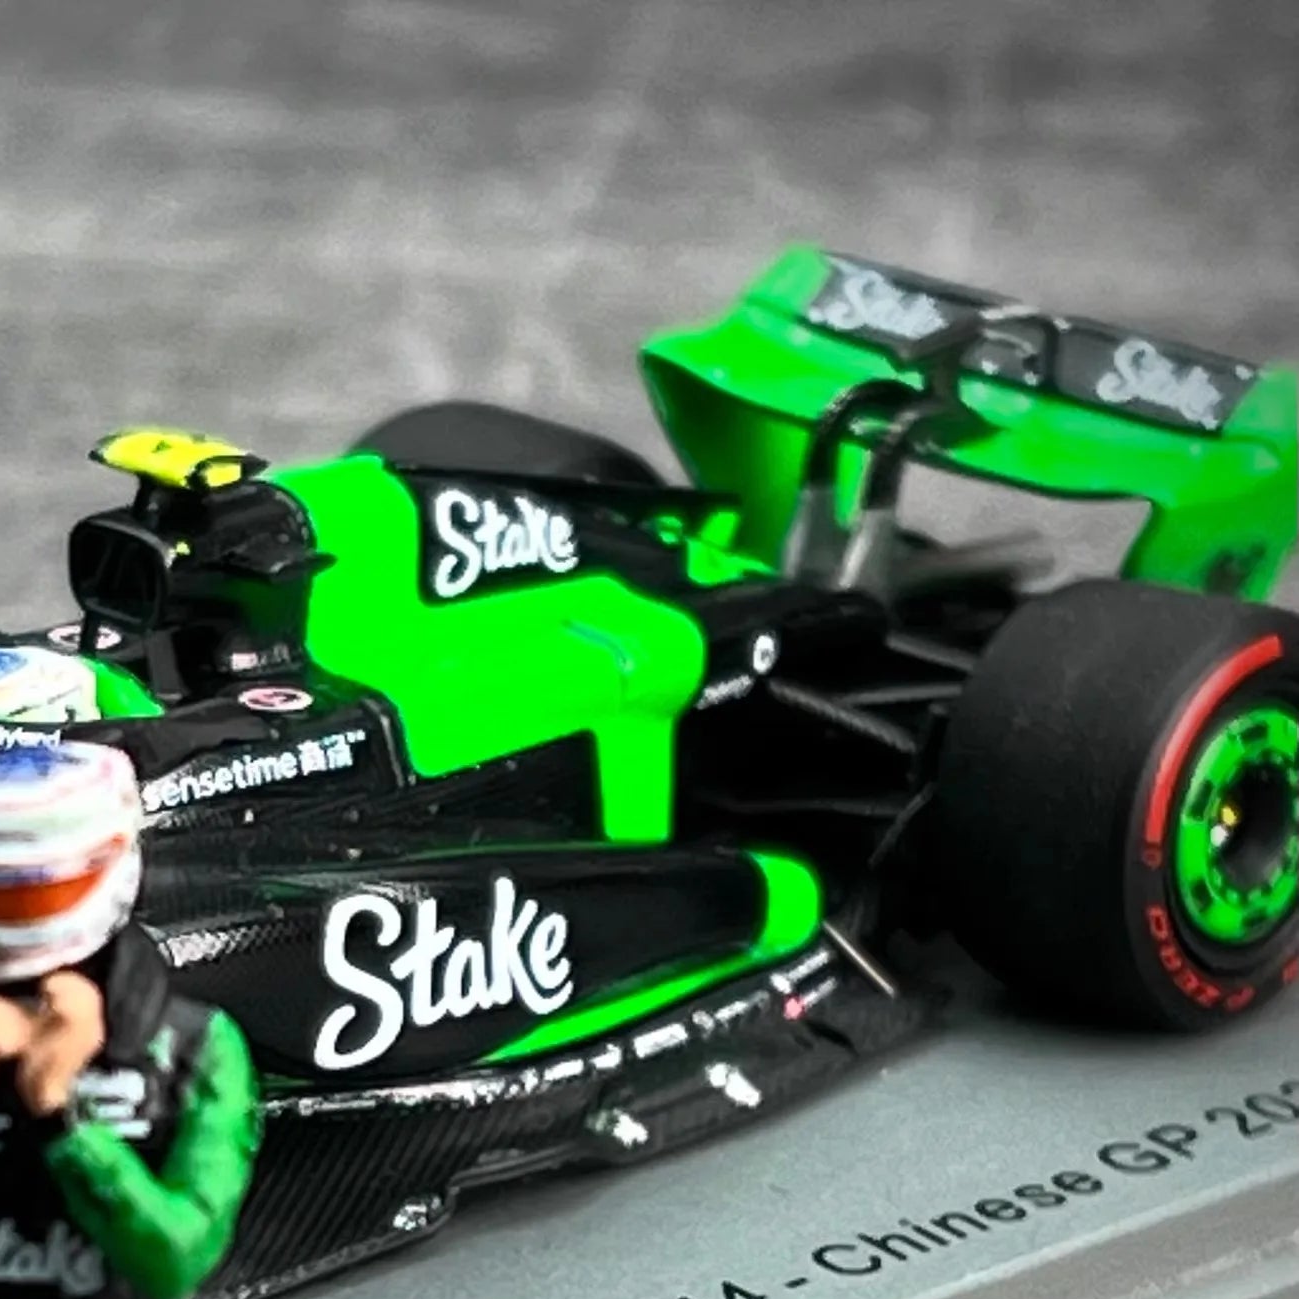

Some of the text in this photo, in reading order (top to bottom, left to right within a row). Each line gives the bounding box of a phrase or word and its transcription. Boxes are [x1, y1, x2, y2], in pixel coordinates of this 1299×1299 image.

[431, 488, 579, 598] Stake
[313, 876, 575, 1072] Stake
[812, 1168, 1104, 1279] Chinese
[1098, 1123, 1198, 1175] GP
